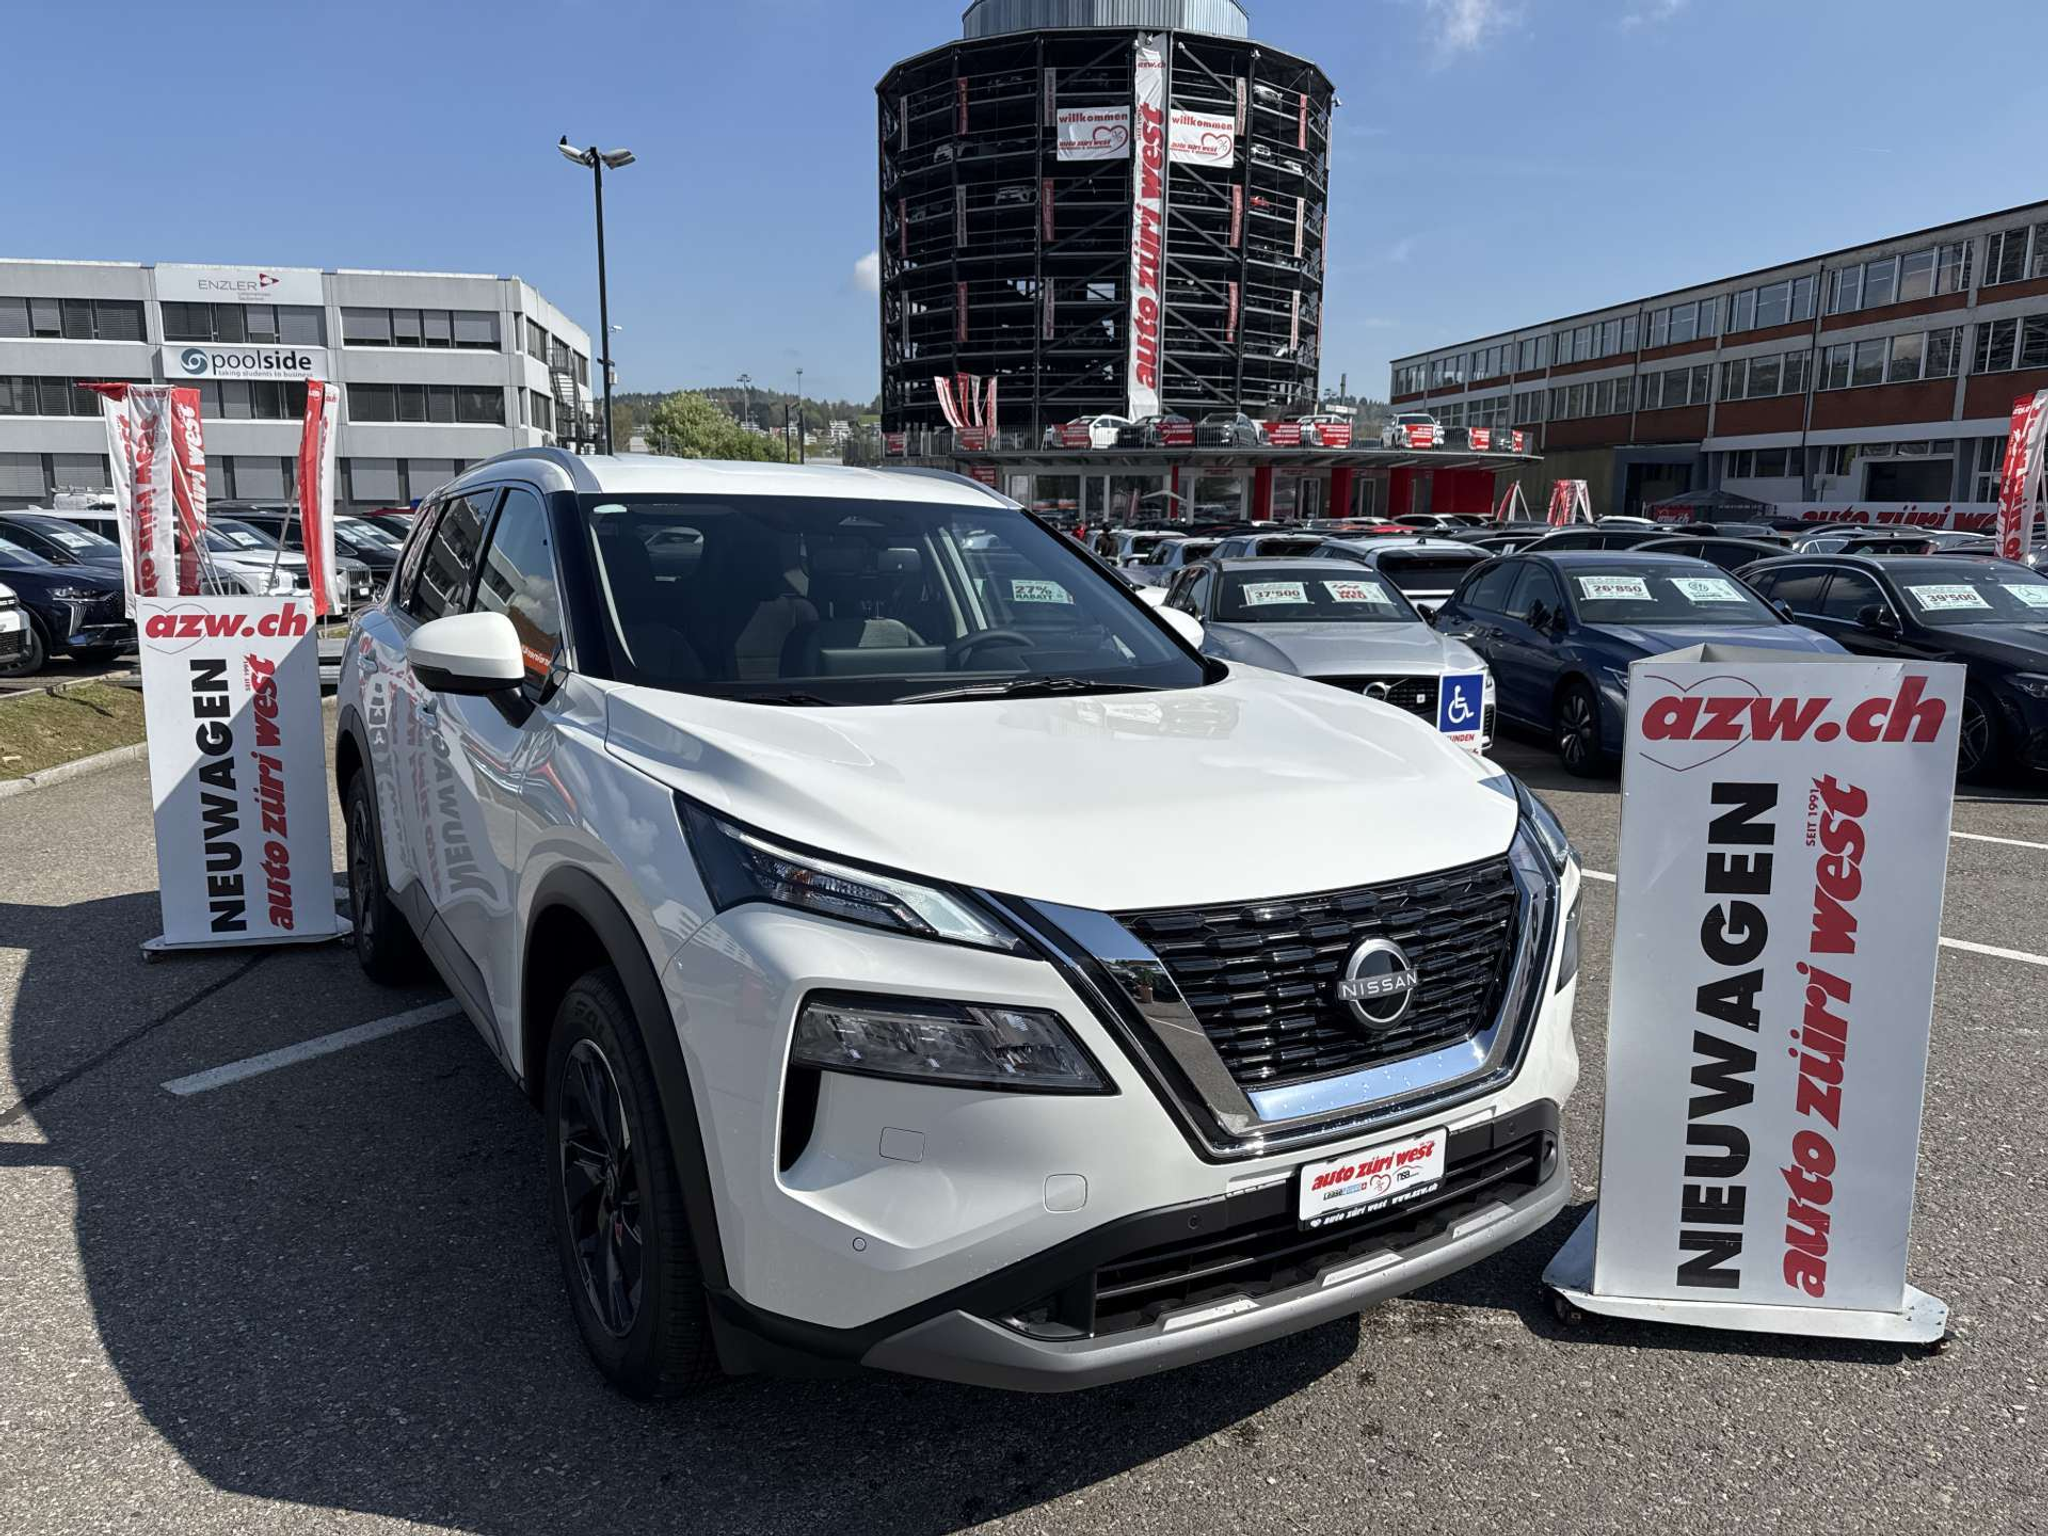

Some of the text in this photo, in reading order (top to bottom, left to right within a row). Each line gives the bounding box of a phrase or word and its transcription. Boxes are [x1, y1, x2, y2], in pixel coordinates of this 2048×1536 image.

[1059, 113, 1128, 123] willkommen
[1172, 117, 1232, 131] willkommen
[1133, 102, 1165, 391] auto züri west
[199, 279, 257, 291] ENZLER
[212, 350, 312, 375] poolside
[1015, 585, 1052, 595] 27%
[145, 603, 308, 638] azw.ch
[1641, 676, 1946, 743] azw.ch
[190, 659, 247, 933] NEUWAGEN
[243, 653, 294, 931] auto züri west
[1806, 789, 1819, 846] SEIT 1991
[1342, 970, 1417, 998] NISSAN
[1676, 782, 1779, 1290] NEUWAGEN
[1779, 774, 1869, 1298] auto züri west
[1311, 1141, 1434, 1191] auto züri west
[1323, 1212, 1345, 1225] auto
[1367, 1199, 1387, 1212] west
